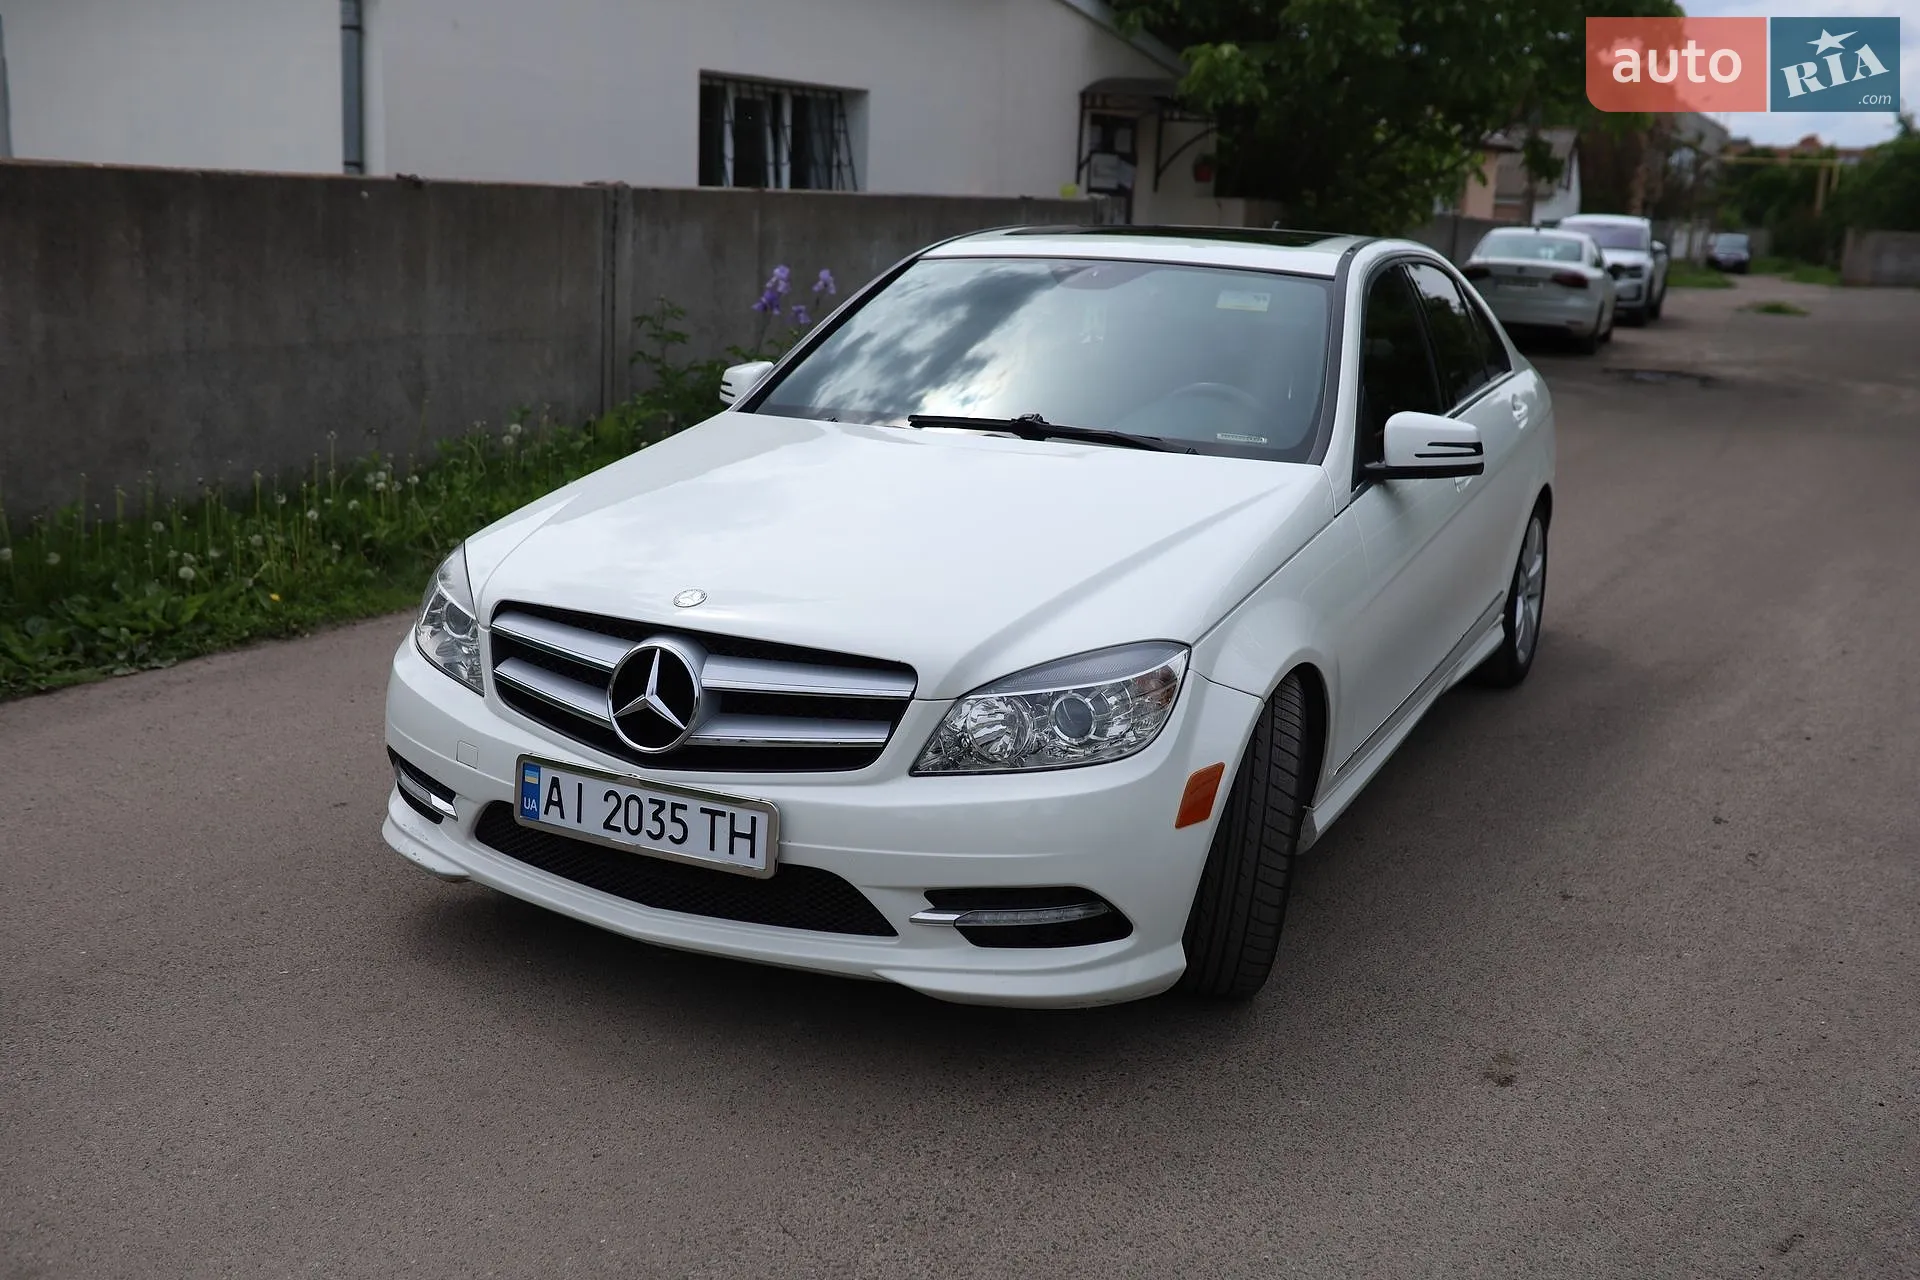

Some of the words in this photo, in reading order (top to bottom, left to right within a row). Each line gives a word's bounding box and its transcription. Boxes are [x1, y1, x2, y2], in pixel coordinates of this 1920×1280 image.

[523, 797, 538, 812] UA
[543, 776, 583, 824] AI
[602, 789, 689, 845] 2035
[699, 806, 757, 859] TH
